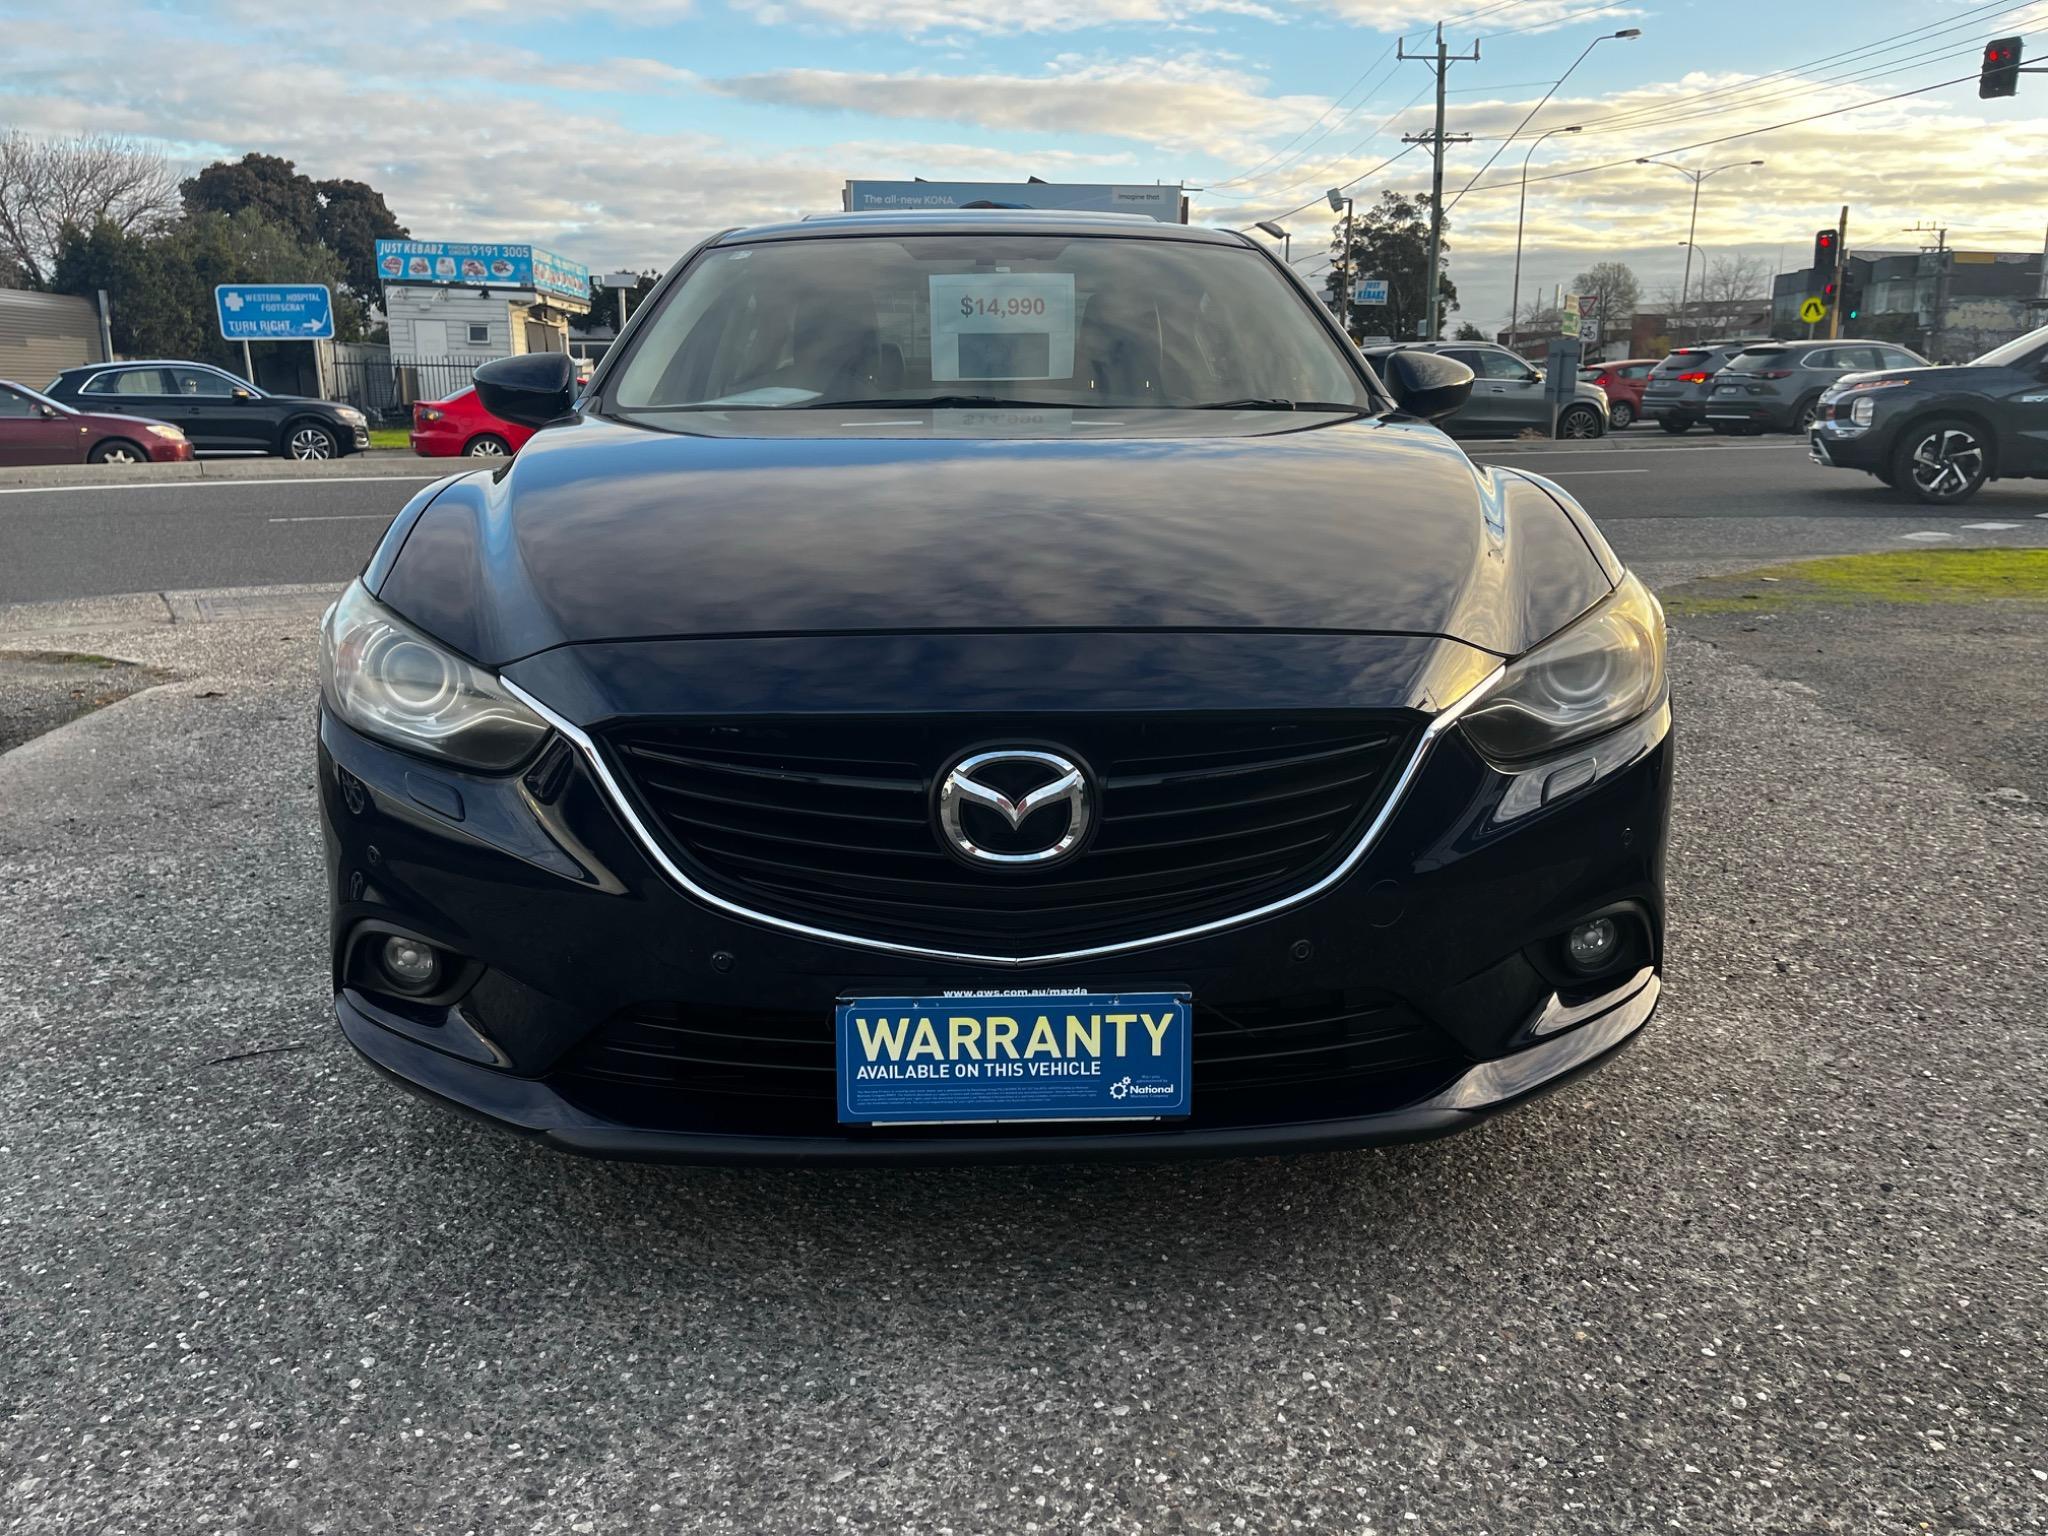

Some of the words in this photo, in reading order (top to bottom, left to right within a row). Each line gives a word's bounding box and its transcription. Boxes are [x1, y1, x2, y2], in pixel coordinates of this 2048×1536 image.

[863, 194, 882, 204] The
[884, 194, 922, 205] all-new
[379, 242, 402, 256] JUST
[403, 242, 444, 255] KEBABZ
[471, 244, 498, 257] 9191
[502, 245, 530, 258] 3005
[244, 293, 282, 303] WESTERN
[286, 293, 321, 302] HOSPITAL
[260, 303, 306, 312] FOOTSCRAY
[960, 295, 1046, 318] $14,990
[228, 319, 257, 332] TURN
[260, 319, 291, 331] RIGHT
[855, 1013, 1175, 1062] WARRANTY
[856, 1063, 950, 1080] AVAILABLE
[955, 1063, 979, 1078] ON
[984, 1062, 1024, 1077] THIS
[1028, 1061, 1102, 1077] VEHICLE
[1129, 1083, 1174, 1094] National
